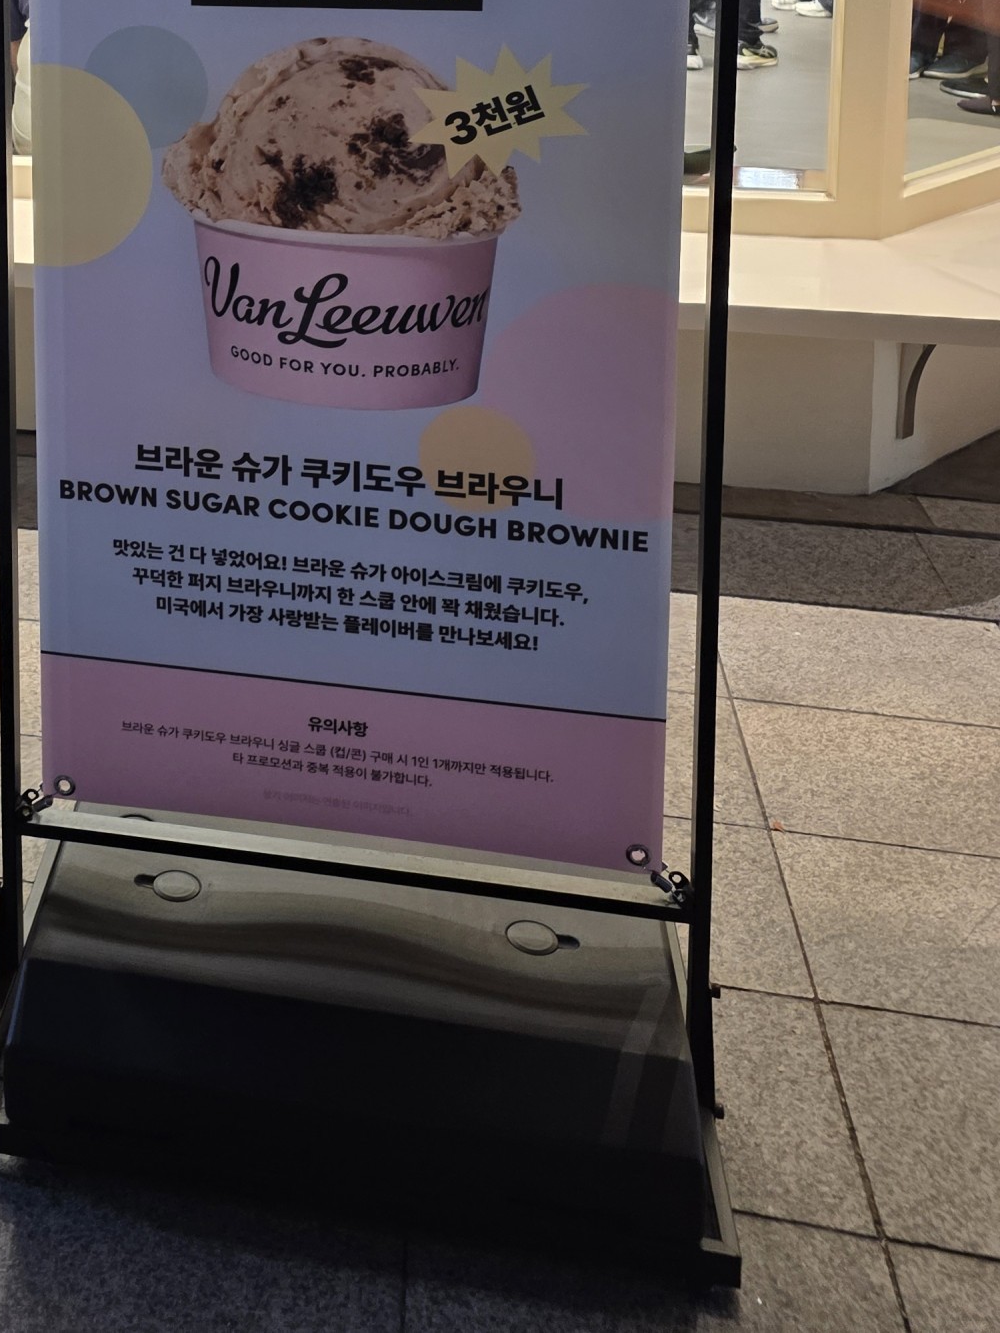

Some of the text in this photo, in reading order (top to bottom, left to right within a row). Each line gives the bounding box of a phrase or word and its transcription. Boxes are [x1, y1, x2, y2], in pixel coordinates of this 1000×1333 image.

[445, 85, 545, 145] 3천원
[231, 346, 459, 377] GOOD FOR YOU. PROBABLY.
[135, 445, 562, 510] 브라운 슈가 쿠키도우 브라우니
[60, 480, 648, 552] BROWN SUGAR COOKIE DOUGH BROWNIE
[113, 539, 588, 604] 맛있는 건 다 넣었어요! 브라운 슈가 아이스크림에 쿠키도우,
[133, 568, 183, 588] 꾸덕한
[188, 573, 221, 593] 퍼지
[227, 577, 331, 604] 브라우니까지
[337, 587, 354, 606] 한
[360, 591, 395, 610] 스쿱
[401, 595, 436, 615] 안에
[465, 601, 564, 627] 채웠습니다.
[157, 597, 538, 651] 미국에서 가장 사랑받는 플레이버를 만나보세요!
[122, 721, 553, 783] 브라운 슈가 쿠키도우 브라우니 싱글 스쿱 (컵/콘) 구매 시 1인 1개까지만 적용됩니다.
[308, 717, 368, 737] 유의사항
[233, 753, 432, 787] 타 프로모션과 중복 적용이 불가합니다.
